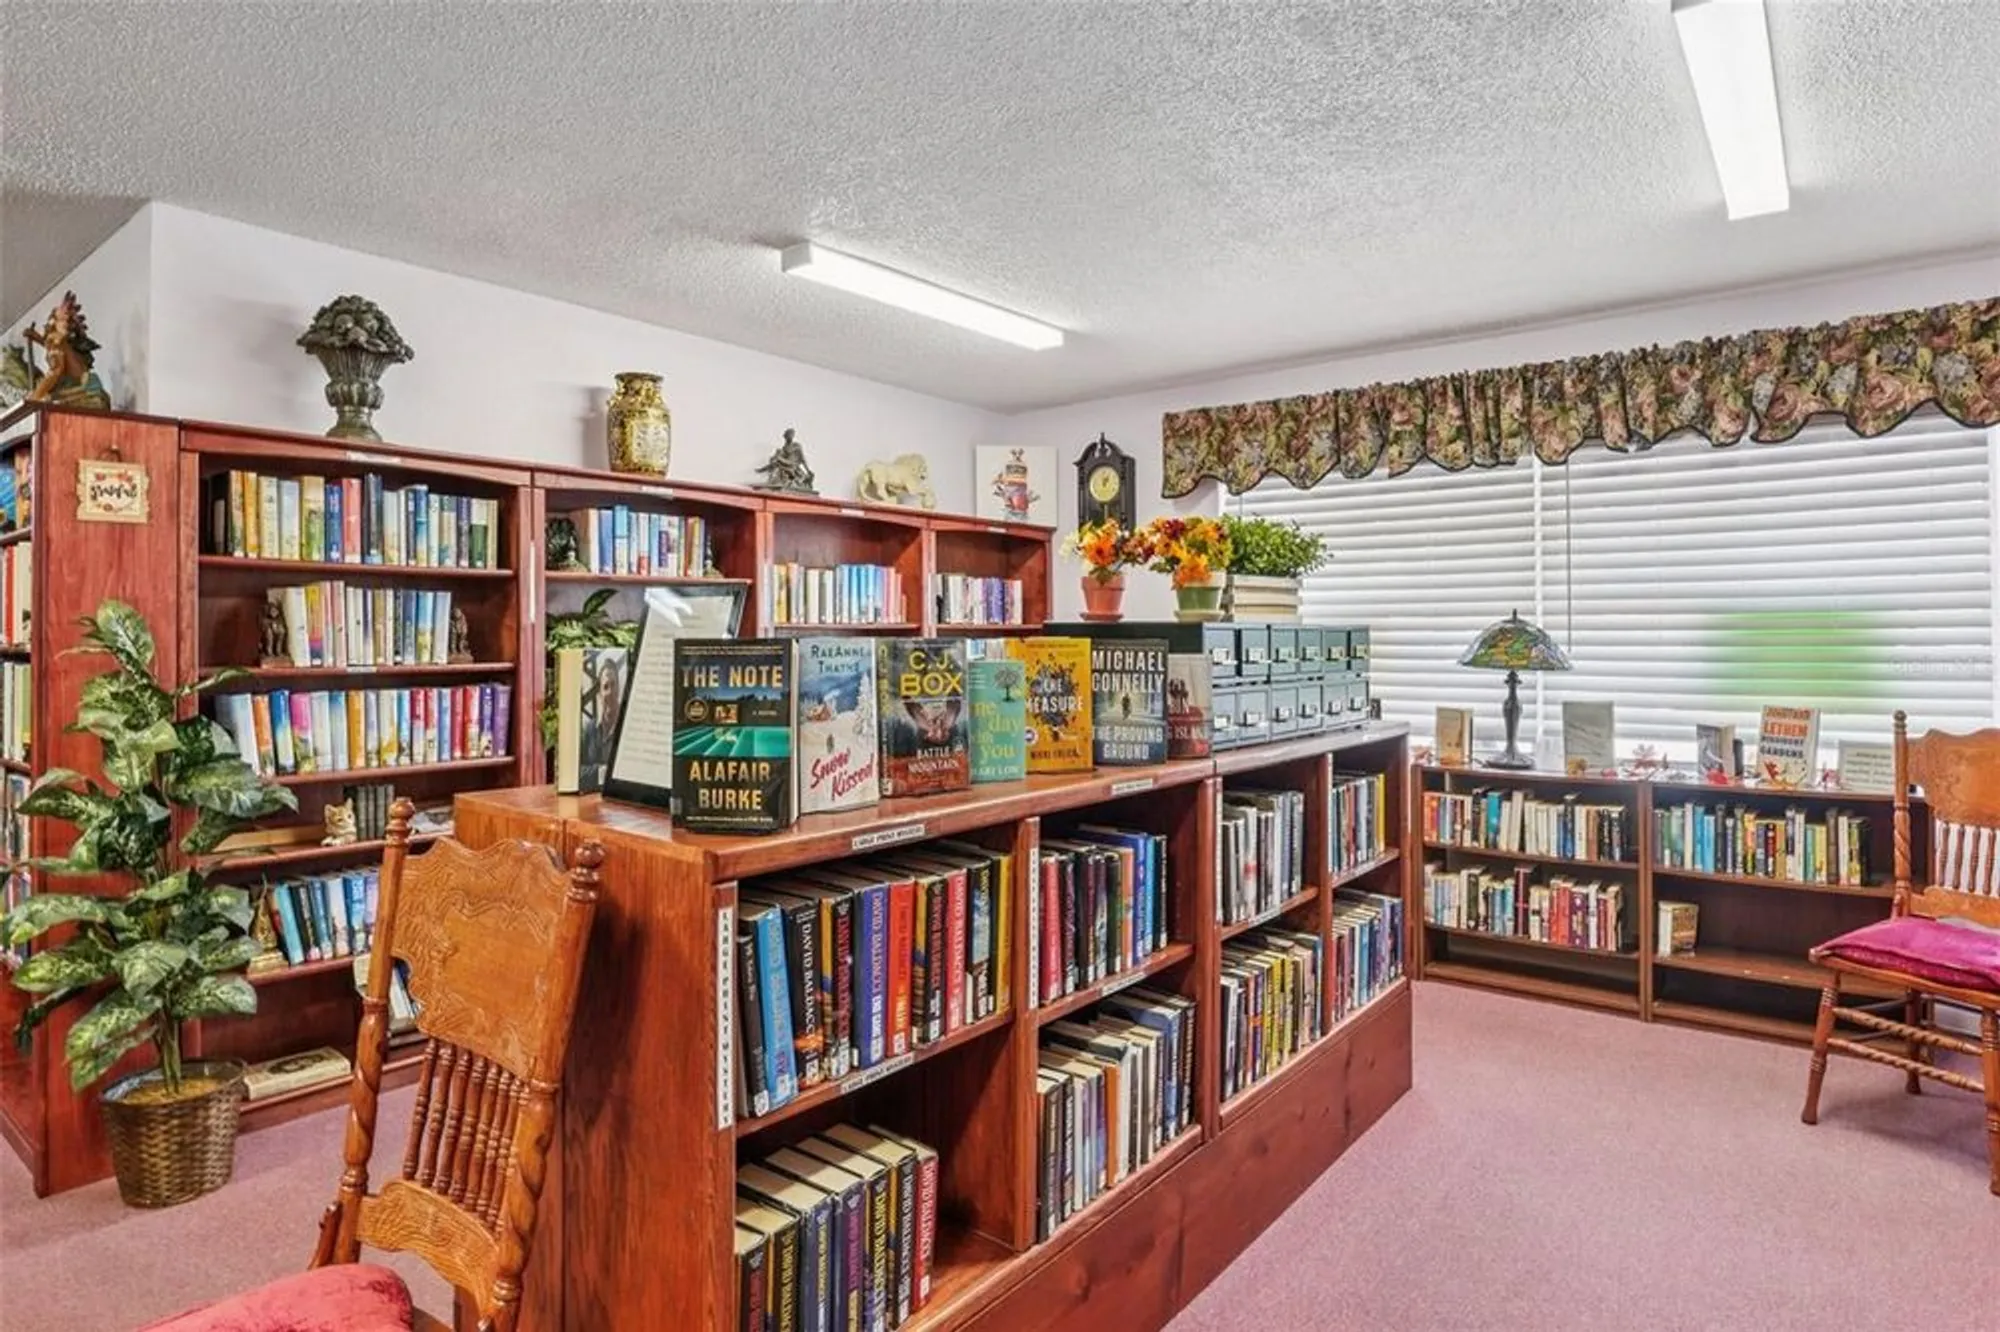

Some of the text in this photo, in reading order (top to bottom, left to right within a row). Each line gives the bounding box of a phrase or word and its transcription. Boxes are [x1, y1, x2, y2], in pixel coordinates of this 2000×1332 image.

[1092, 650, 1165, 671] MICHAEL
[681, 665, 784, 688] THE NOTE
[901, 672, 963, 696] BOX
[1092, 672, 1164, 693] CONNELLY
[1027, 695, 1084, 713] MEASURE
[1103, 742, 1150, 760] GROUND
[689, 761, 771, 782] ALAFAIR
[699, 788, 763, 810] BURKE
[802, 924, 815, 1038] DAVID BALDACC
